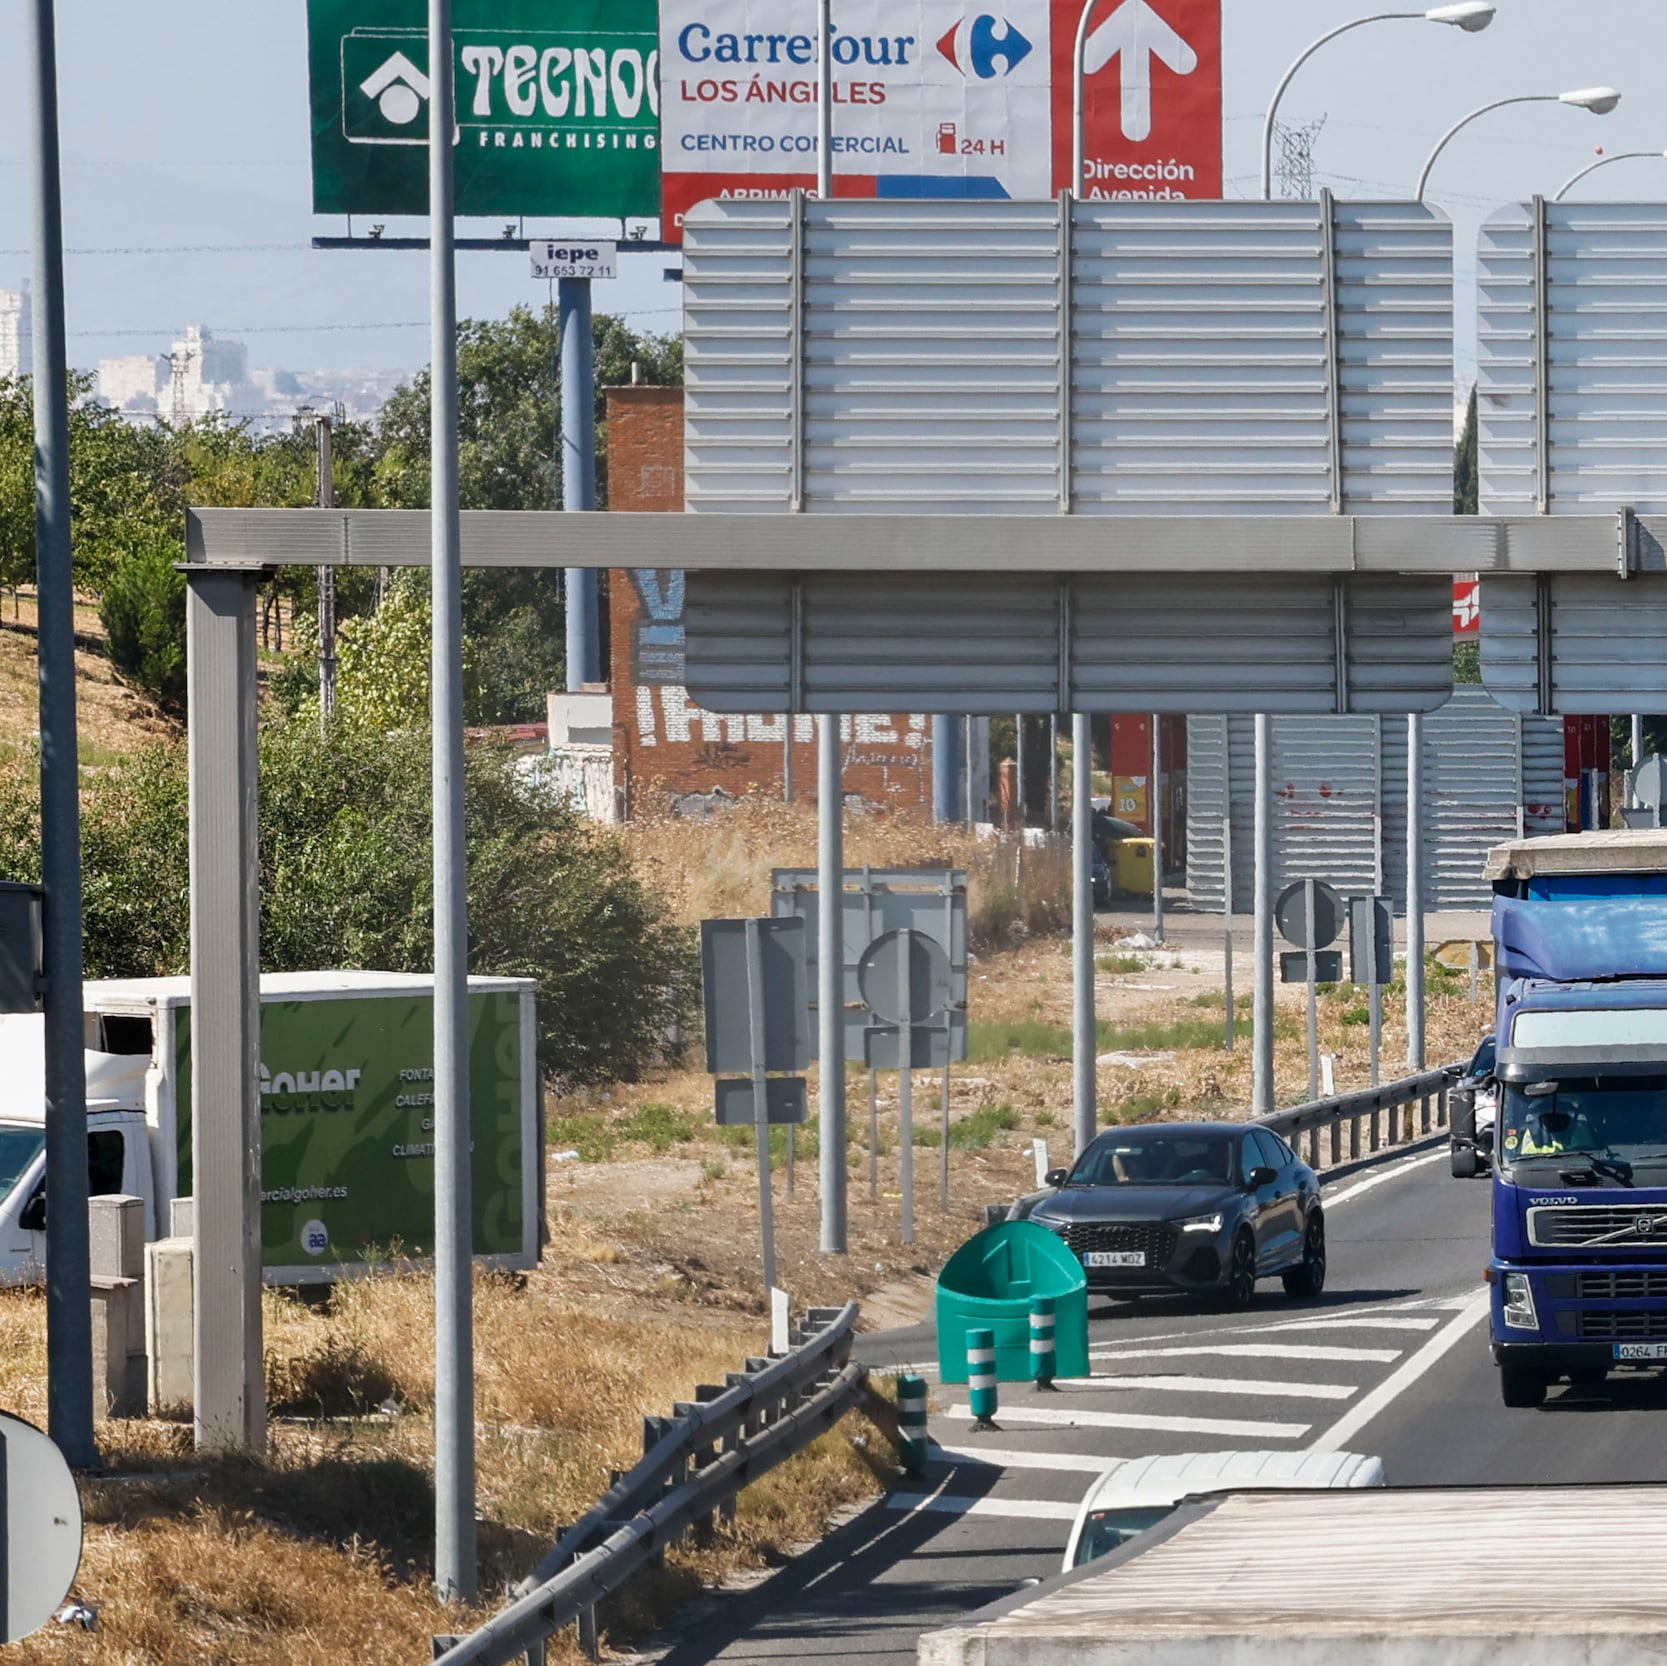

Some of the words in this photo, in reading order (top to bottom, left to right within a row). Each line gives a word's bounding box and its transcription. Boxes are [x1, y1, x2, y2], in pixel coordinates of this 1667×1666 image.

[679, 23, 915, 65] Carreour
[681, 80, 739, 102] LOS
[746, 73, 887, 104] ÁNGLES
[480, 132, 656, 149] FRANCHISING
[681, 135, 775, 152] CENTRO
[961, 140, 986, 155] 24
[990, 140, 1005, 155] H
[1084, 158, 1195, 180] Dirección
[547, 245, 599, 261] iepe
[535, 265, 552, 276] 91
[555, 265, 579, 276] 653
[581, 265, 596, 276] 72
[598, 265, 612, 276] 11
[400, 1068, 434, 1081] FONTA
[395, 1093, 434, 1107] CALEFA
[1530, 1196, 1578, 1205] VOLVO
[1091, 1255, 1118, 1265] 4214
[1622, 1346, 1651, 1358] 0264
